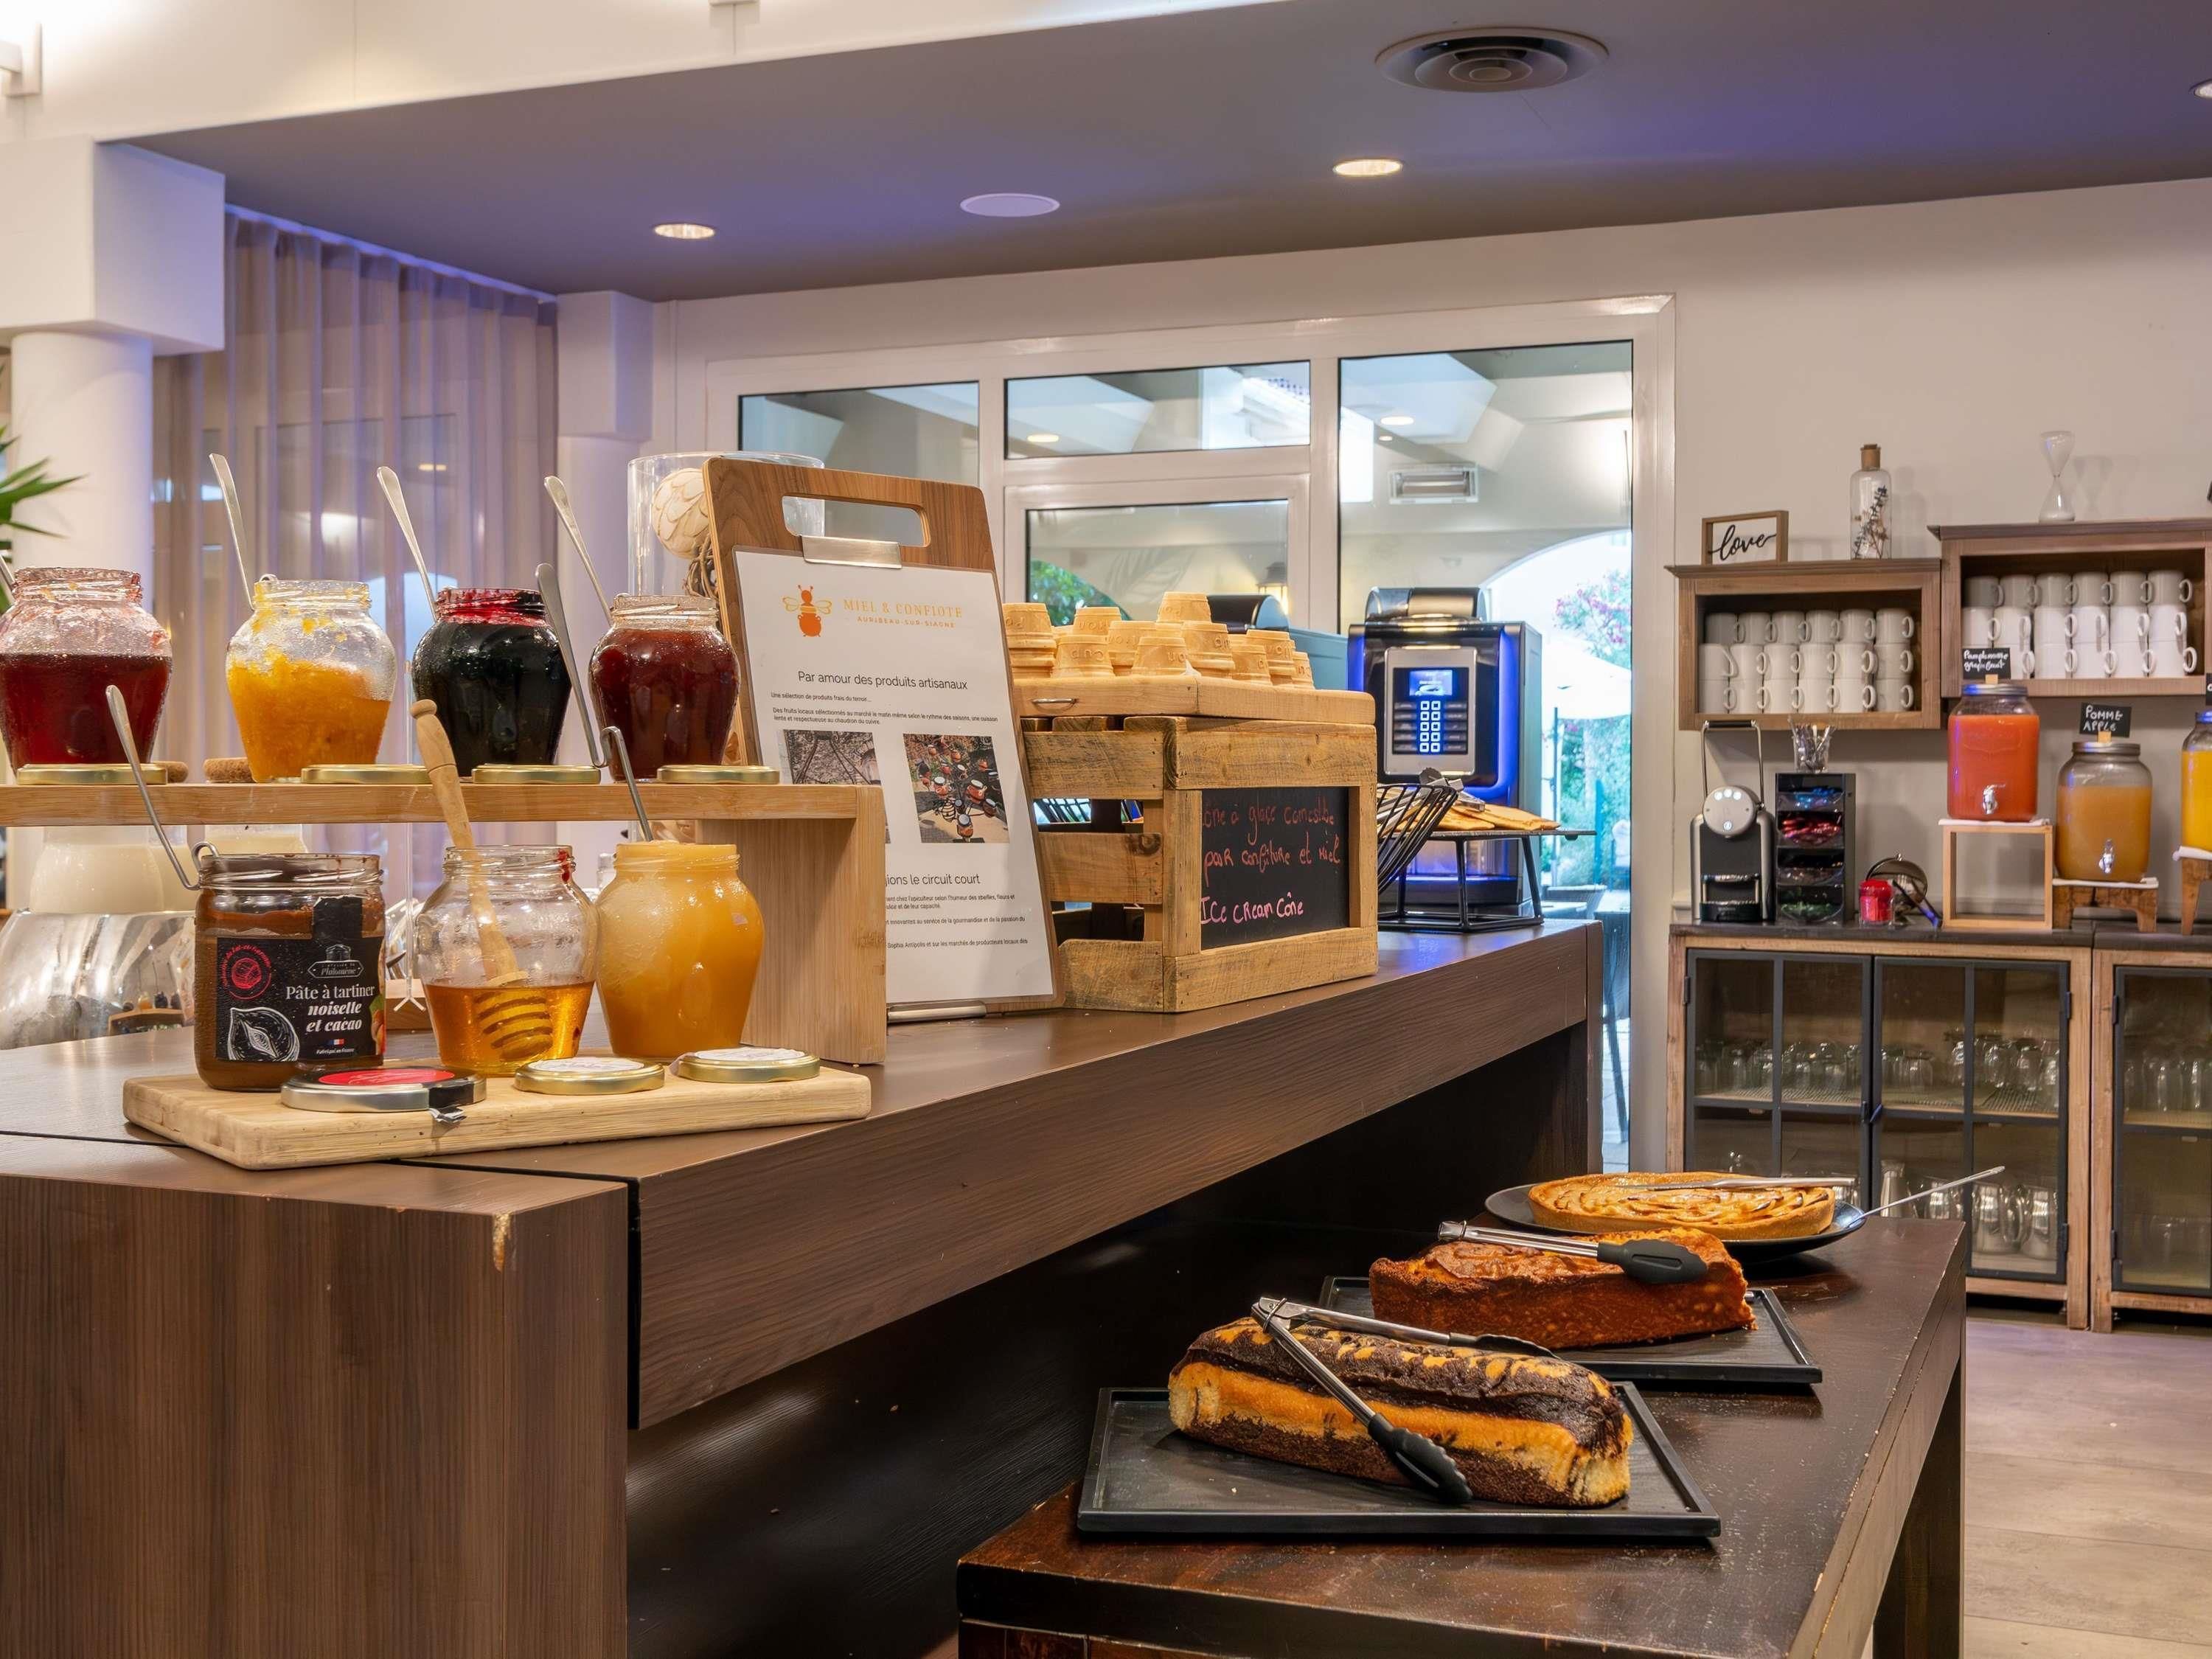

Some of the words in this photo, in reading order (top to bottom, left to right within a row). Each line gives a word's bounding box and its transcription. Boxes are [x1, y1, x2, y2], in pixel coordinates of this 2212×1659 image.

[1708, 524, 1777, 560] love
[844, 599, 876, 613] MIEL
[882, 602, 891, 614] &
[896, 603, 962, 618] CONFIOTE
[798, 670, 815, 682] Par
[818, 674, 851, 684] amour
[855, 674, 873, 685] des
[875, 675, 916, 690] produits
[918, 678, 968, 690] artisanaux
[1299, 832, 1312, 865] et
[910, 874, 919, 885] le
[922, 874, 953, 885] circuit
[954, 873, 980, 884] court
[286, 985, 318, 1000] Pâte
[321, 984, 331, 999] à
[333, 984, 375, 998] tartiner
[307, 1001, 362, 1016] noisette
[306, 1020, 321, 1032] et
[324, 1020, 362, 1032] cacao
